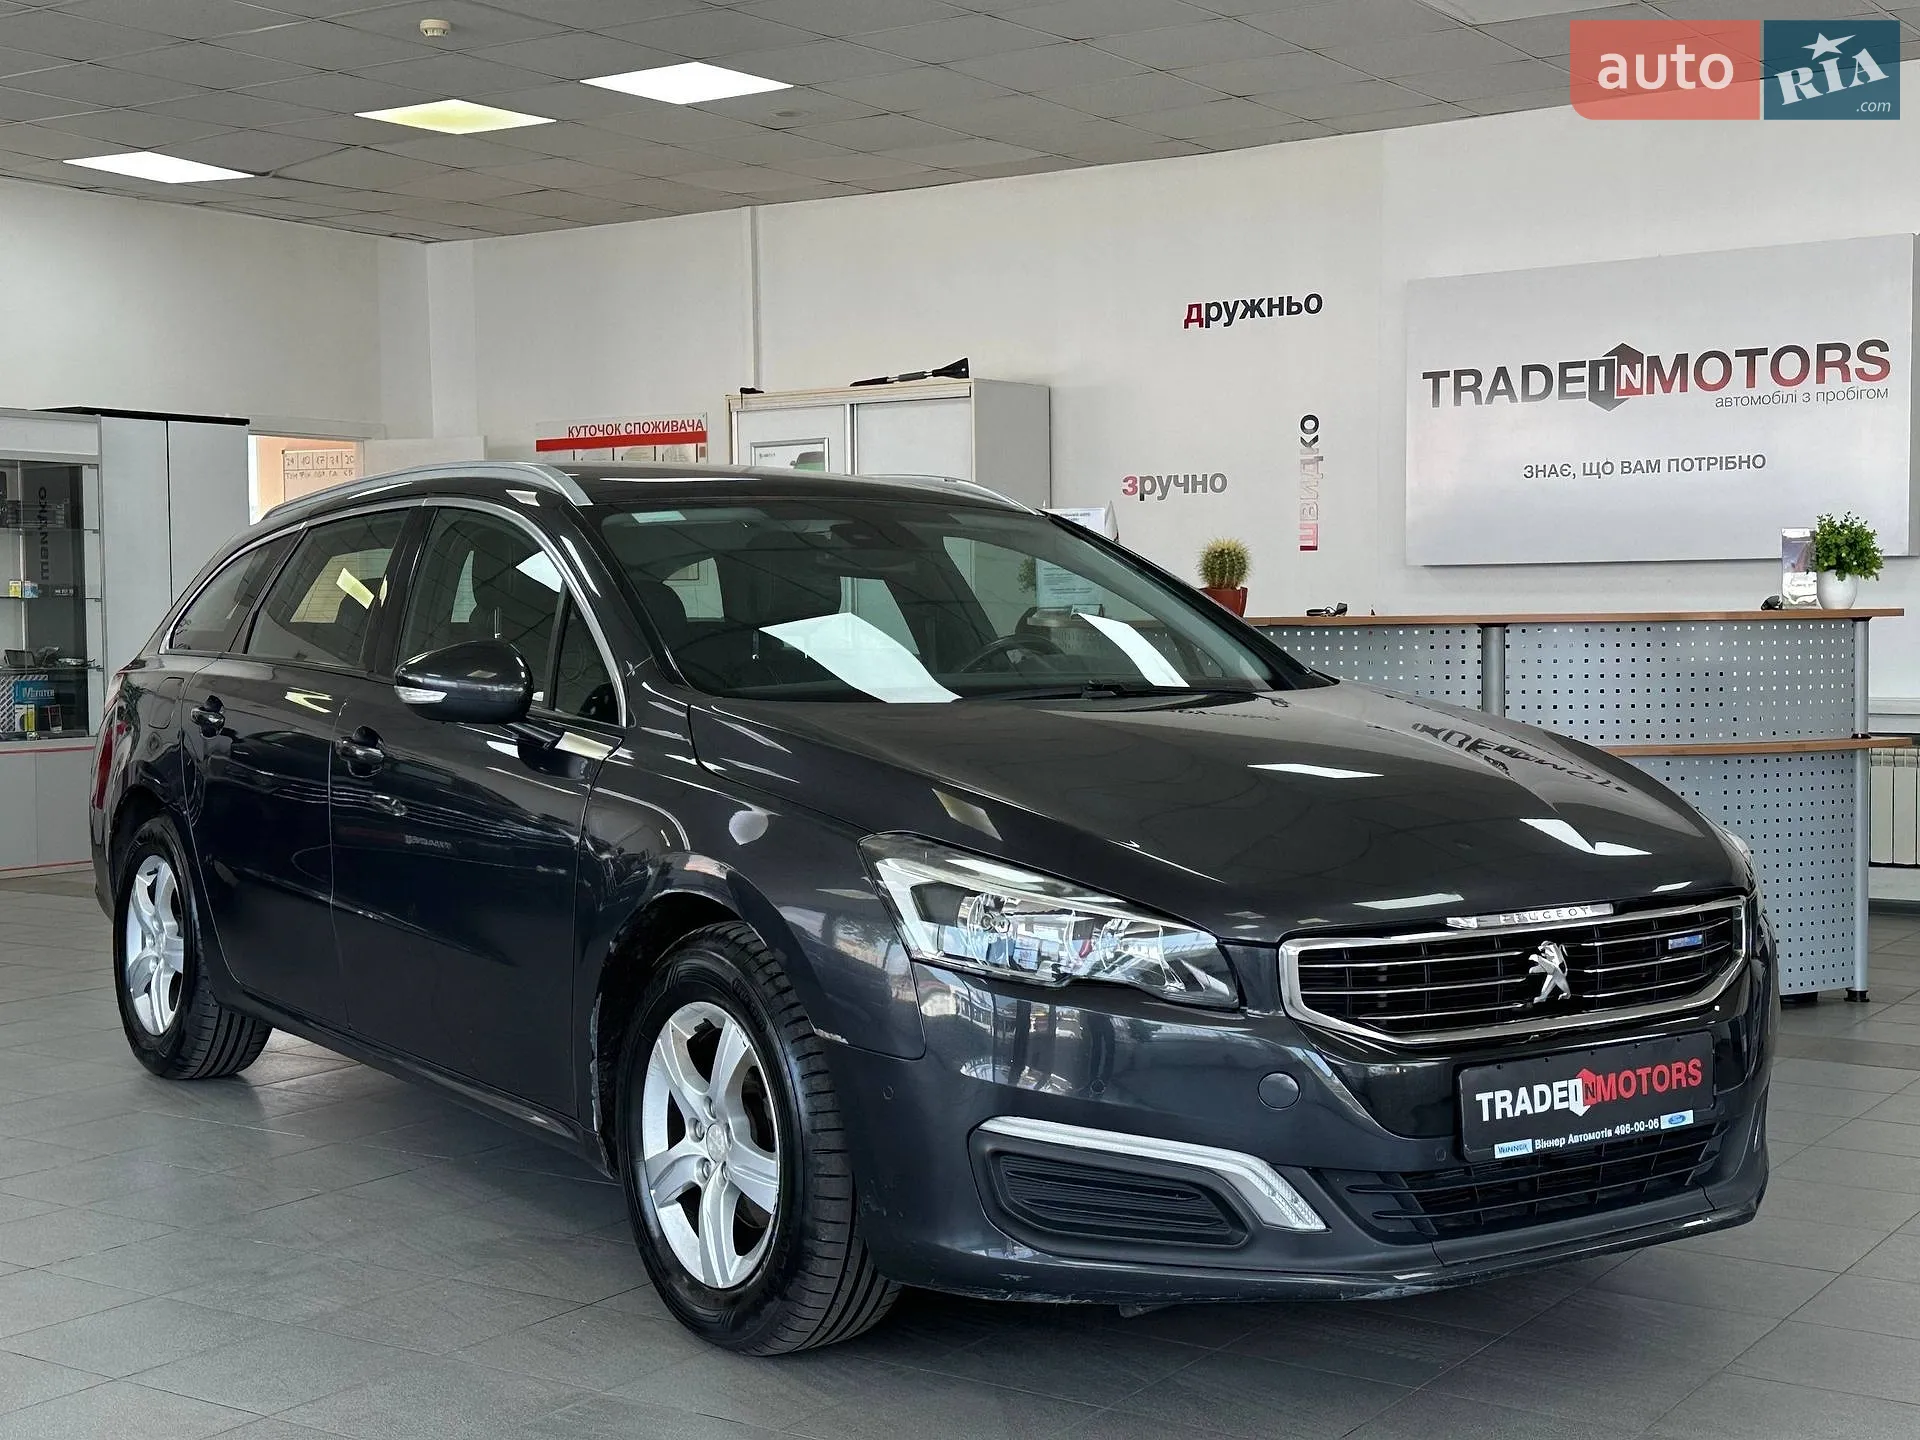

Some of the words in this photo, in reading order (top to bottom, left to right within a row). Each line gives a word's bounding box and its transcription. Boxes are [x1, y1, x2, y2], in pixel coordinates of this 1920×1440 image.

[1183, 292, 1323, 329] дружньо
[1715, 390, 1797, 408] автомобілі
[1802, 391, 1811, 402] з
[1816, 386, 1889, 404] пробігом
[568, 423, 621, 438] КУТОЧОК
[625, 419, 704, 434] СПОЖИВАЧА
[1523, 463, 1576, 479] ЗНАЄ,
[1583, 460, 1615, 479] ЩО
[1620, 459, 1661, 475] ВАМ
[1667, 454, 1766, 473] ПОТРІБНО
[1122, 472, 1228, 501] зручно
[1299, 414, 1323, 551] швидко
[1568, 1128, 1612, 1144] Автомотів
